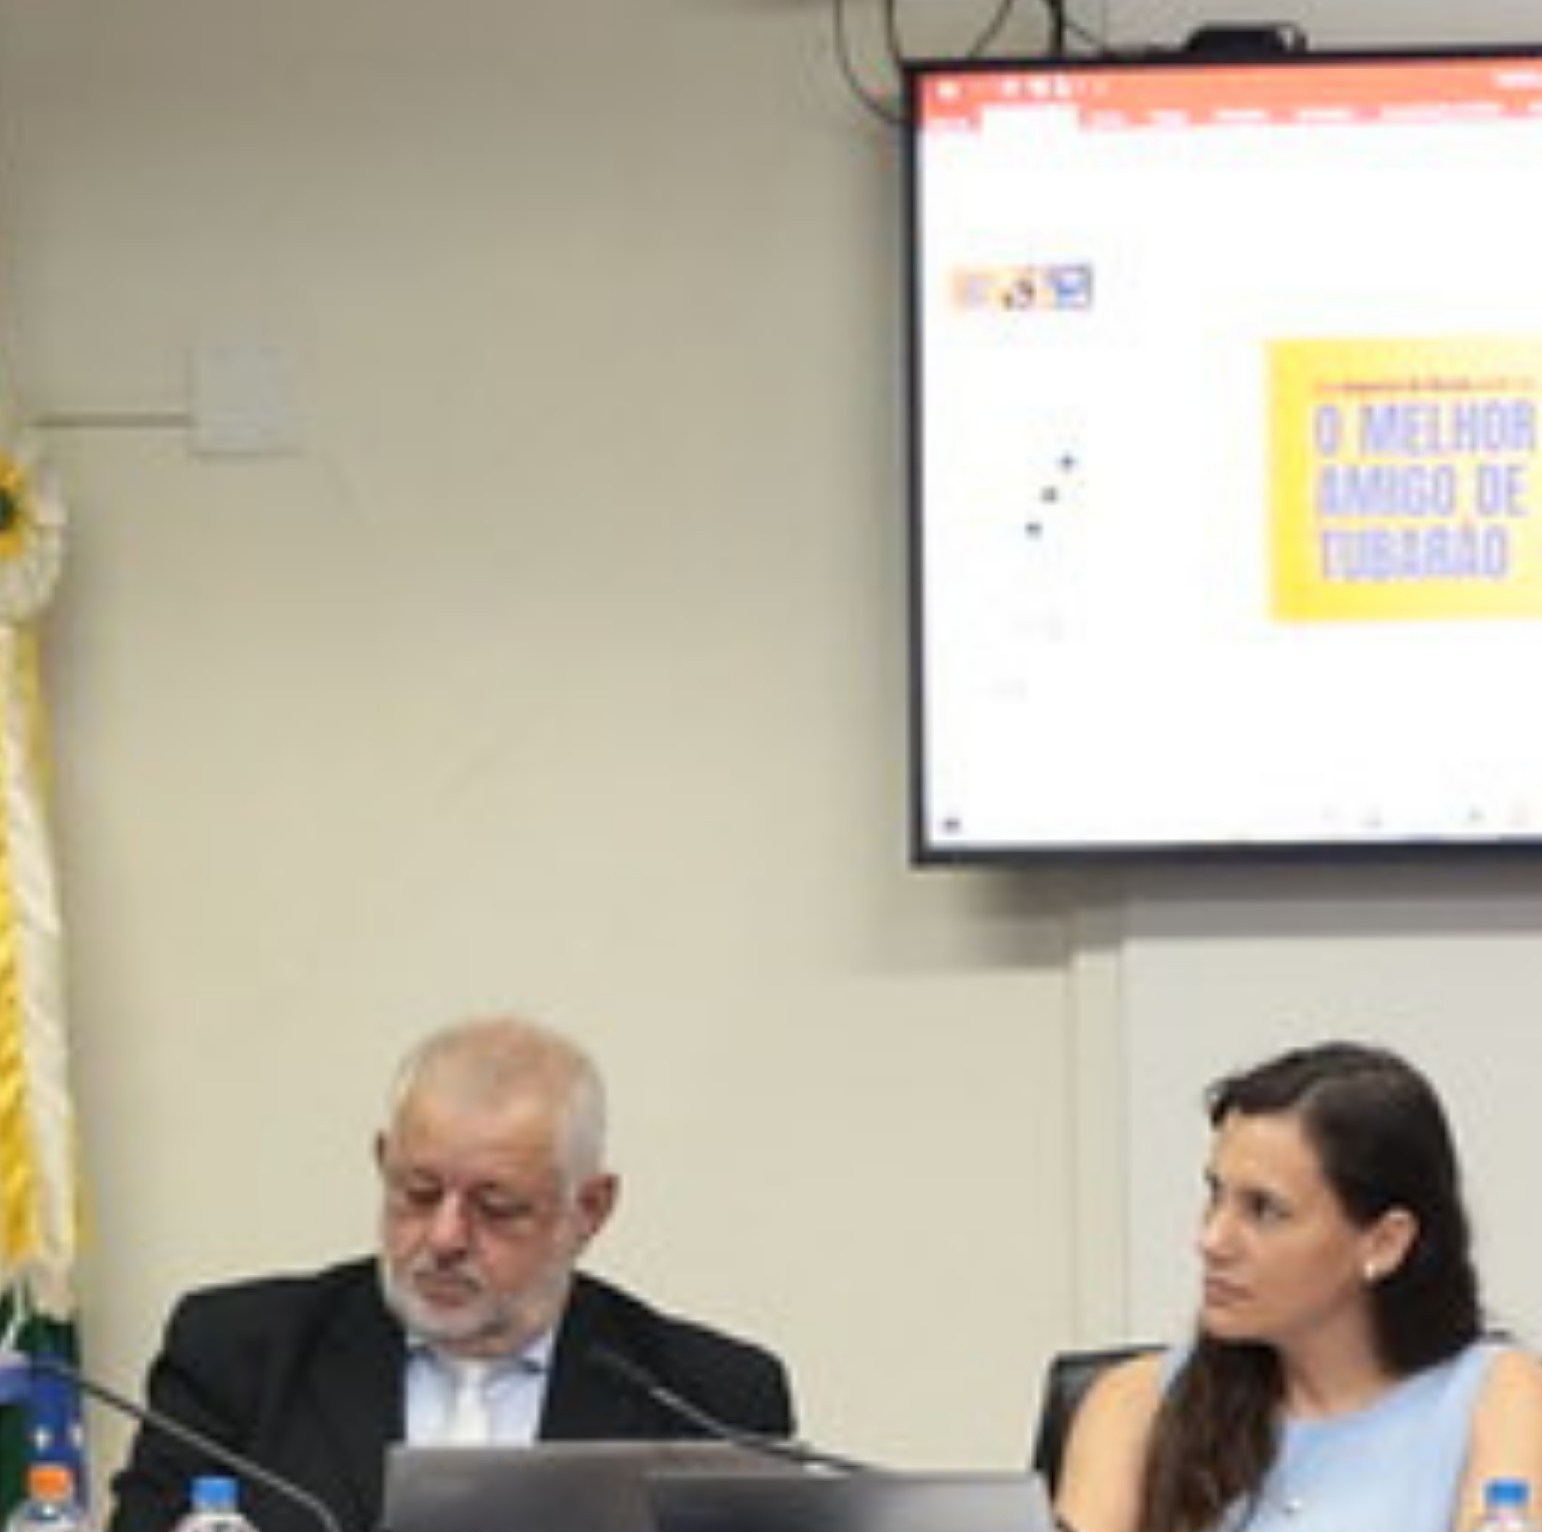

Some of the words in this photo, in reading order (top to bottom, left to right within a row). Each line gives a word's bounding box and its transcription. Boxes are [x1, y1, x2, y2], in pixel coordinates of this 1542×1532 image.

[1315, 402, 1342, 455] O
[1358, 399, 1537, 455] MELHOR
[1318, 463, 1455, 517] AMIGO
[1474, 463, 1529, 517] DE
